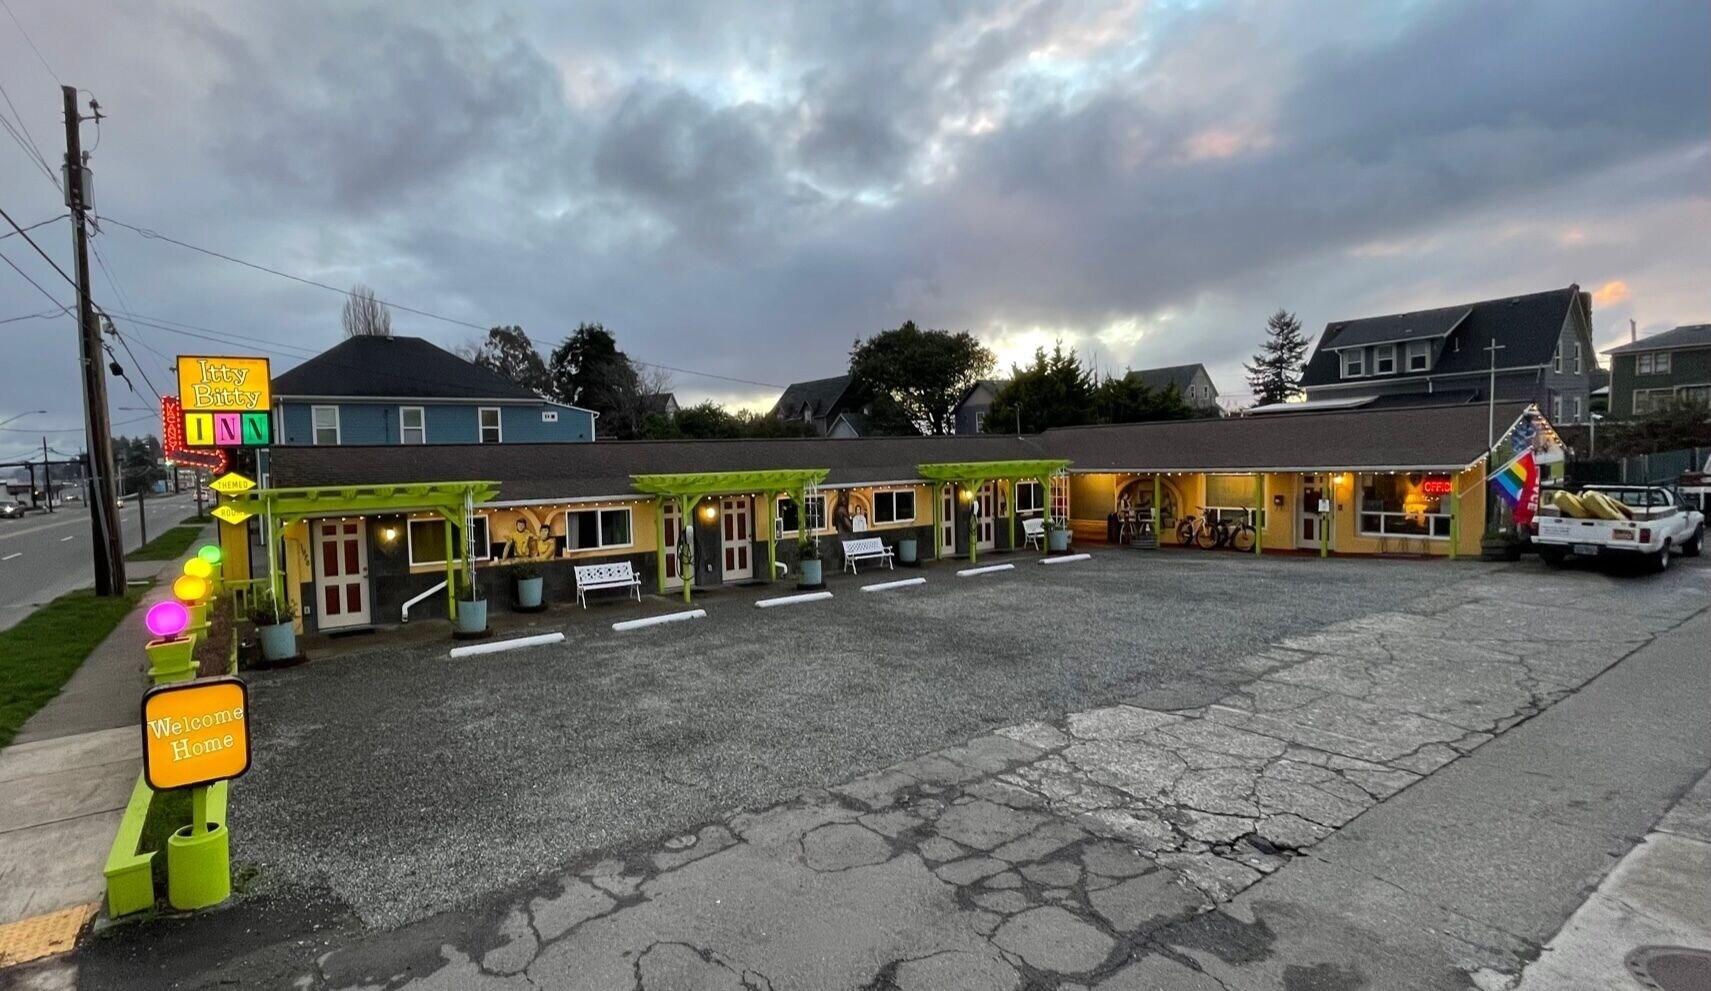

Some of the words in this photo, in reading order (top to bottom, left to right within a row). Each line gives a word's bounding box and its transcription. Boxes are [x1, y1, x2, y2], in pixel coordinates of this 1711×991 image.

[198, 360, 249, 385] Itty
[192, 383, 261, 409] Bitty
[165, 402, 178, 451] VACANCY
[196, 417, 263, 441] INN
[217, 481, 248, 489] THEMED
[220, 508, 246, 517] ROO
[147, 706, 244, 739] Welcome
[170, 734, 234, 762] Home
